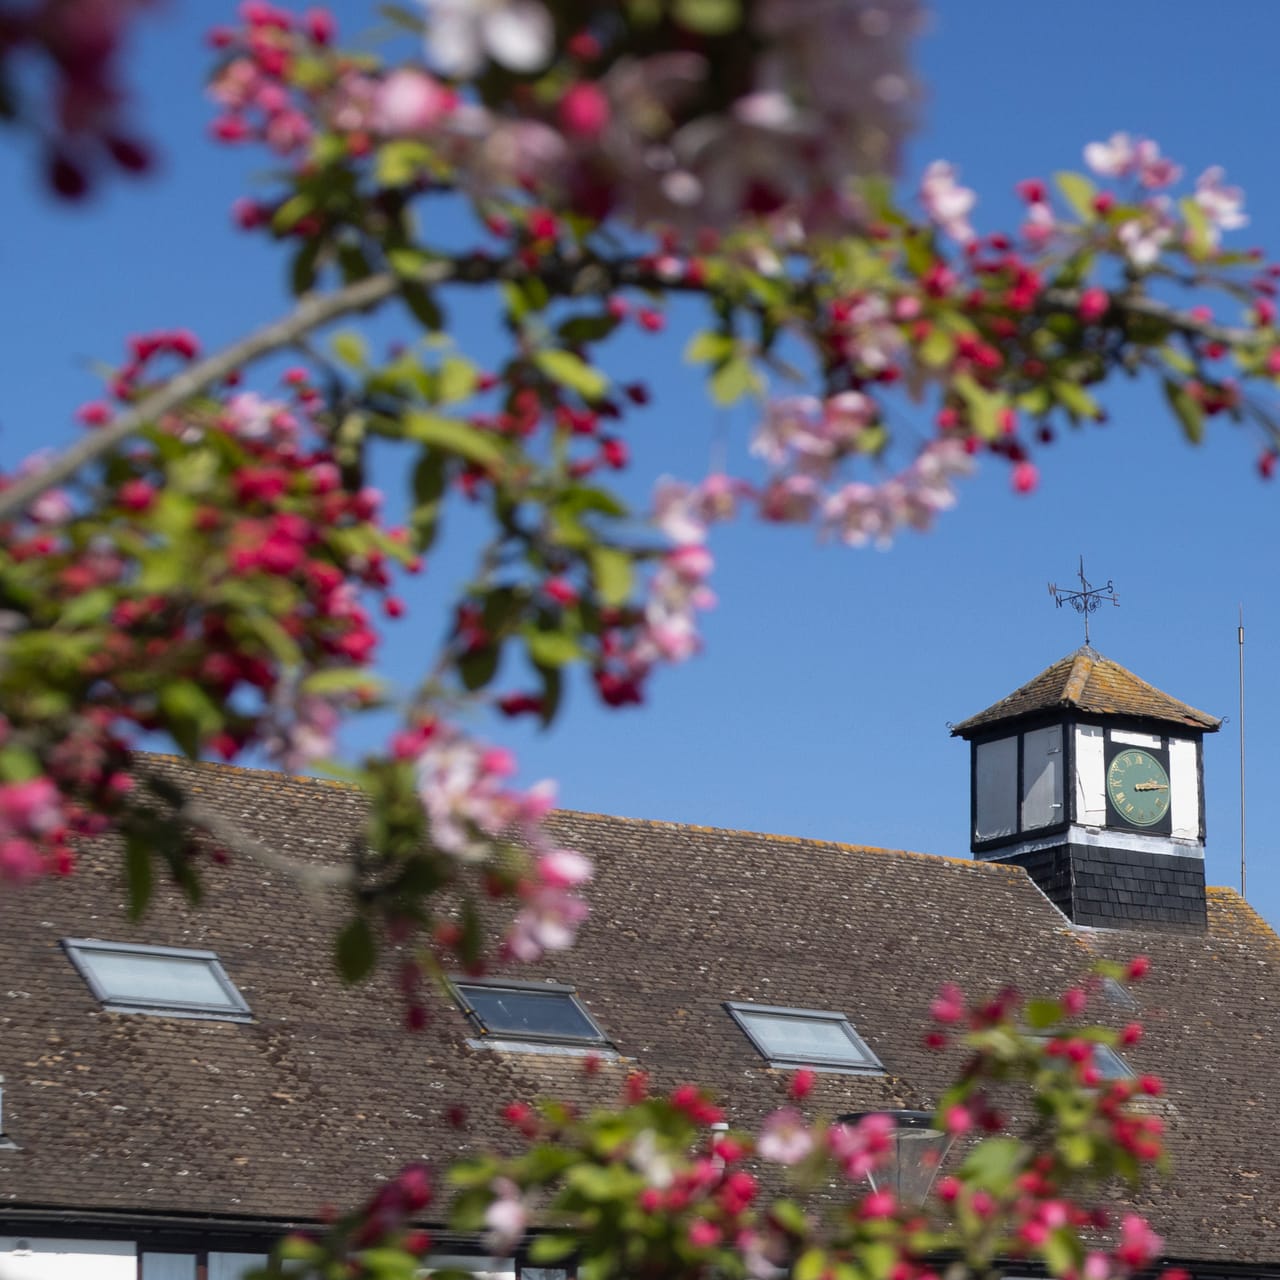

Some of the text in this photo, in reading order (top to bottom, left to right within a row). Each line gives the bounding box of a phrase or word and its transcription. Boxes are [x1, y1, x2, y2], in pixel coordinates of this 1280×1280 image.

[1047, 582, 1057, 597] W
[1107, 580, 1114, 594] S
[1055, 595, 1063, 609] N
[1112, 593, 1121, 607] E
